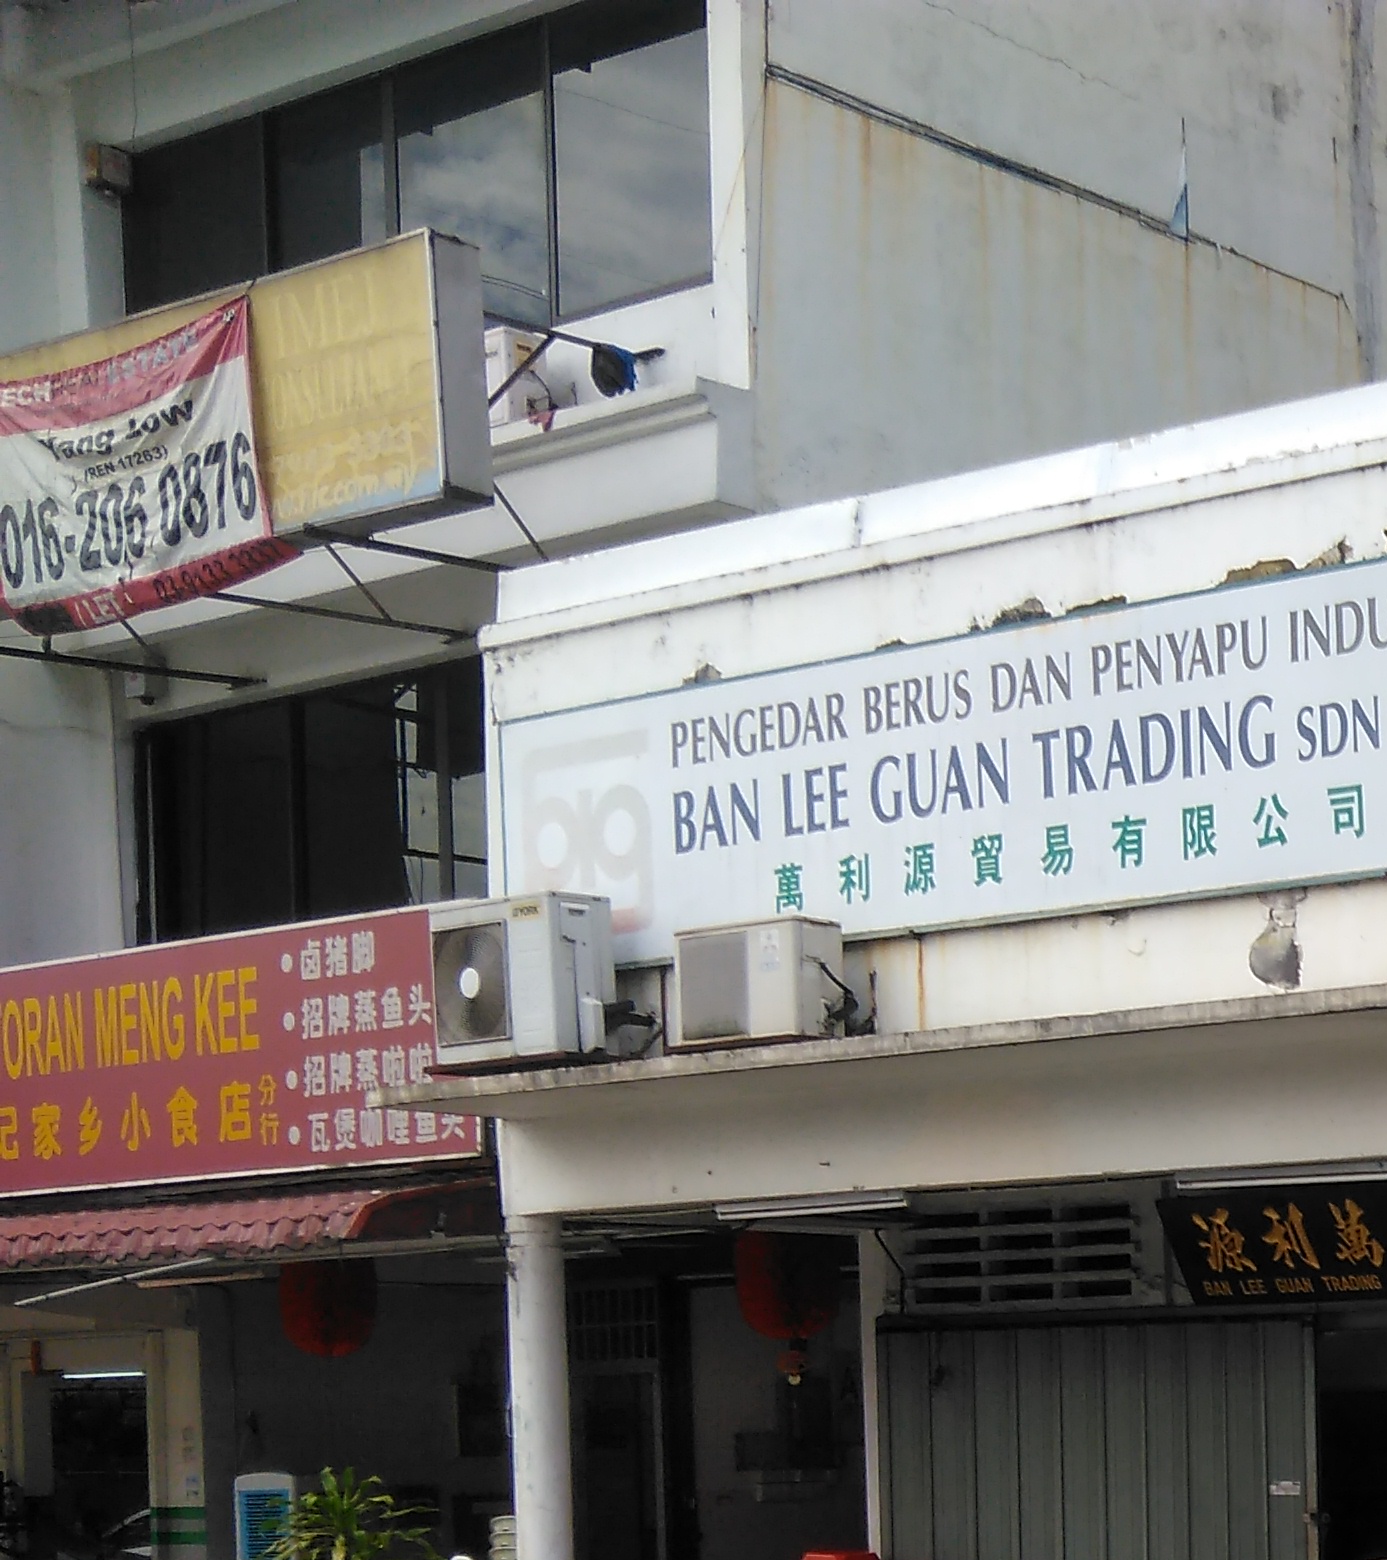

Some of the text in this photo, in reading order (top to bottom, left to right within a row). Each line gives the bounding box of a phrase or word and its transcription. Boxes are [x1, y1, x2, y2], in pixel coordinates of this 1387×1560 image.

[0, 475, 148, 590] 016-206
[158, 431, 258, 547] 0876
[38, 429, 116, 461] Yang
[670, 692, 849, 769] PENGEDAR
[863, 669, 973, 736] BERUS
[990, 651, 1073, 714] DAN
[1091, 616, 1269, 697] PENYAPU
[673, 778, 763, 855] BAN
[780, 762, 851, 838] LEE
[869, 738, 1011, 826] GUAN
[1031, 694, 1277, 800] TRADING
[1297, 695, 1382, 762] SDN
[773, 782, 1367, 915] 萬利源貿易有限公司
[0, 966, 260, 1080] ORAN MENG KEE
[1202, 1276, 1234, 1298] BAN
[1240, 1275, 1269, 1297] LEE
[1274, 1273, 1315, 1296] GUAN
[1322, 1273, 1383, 1294] TRADING
